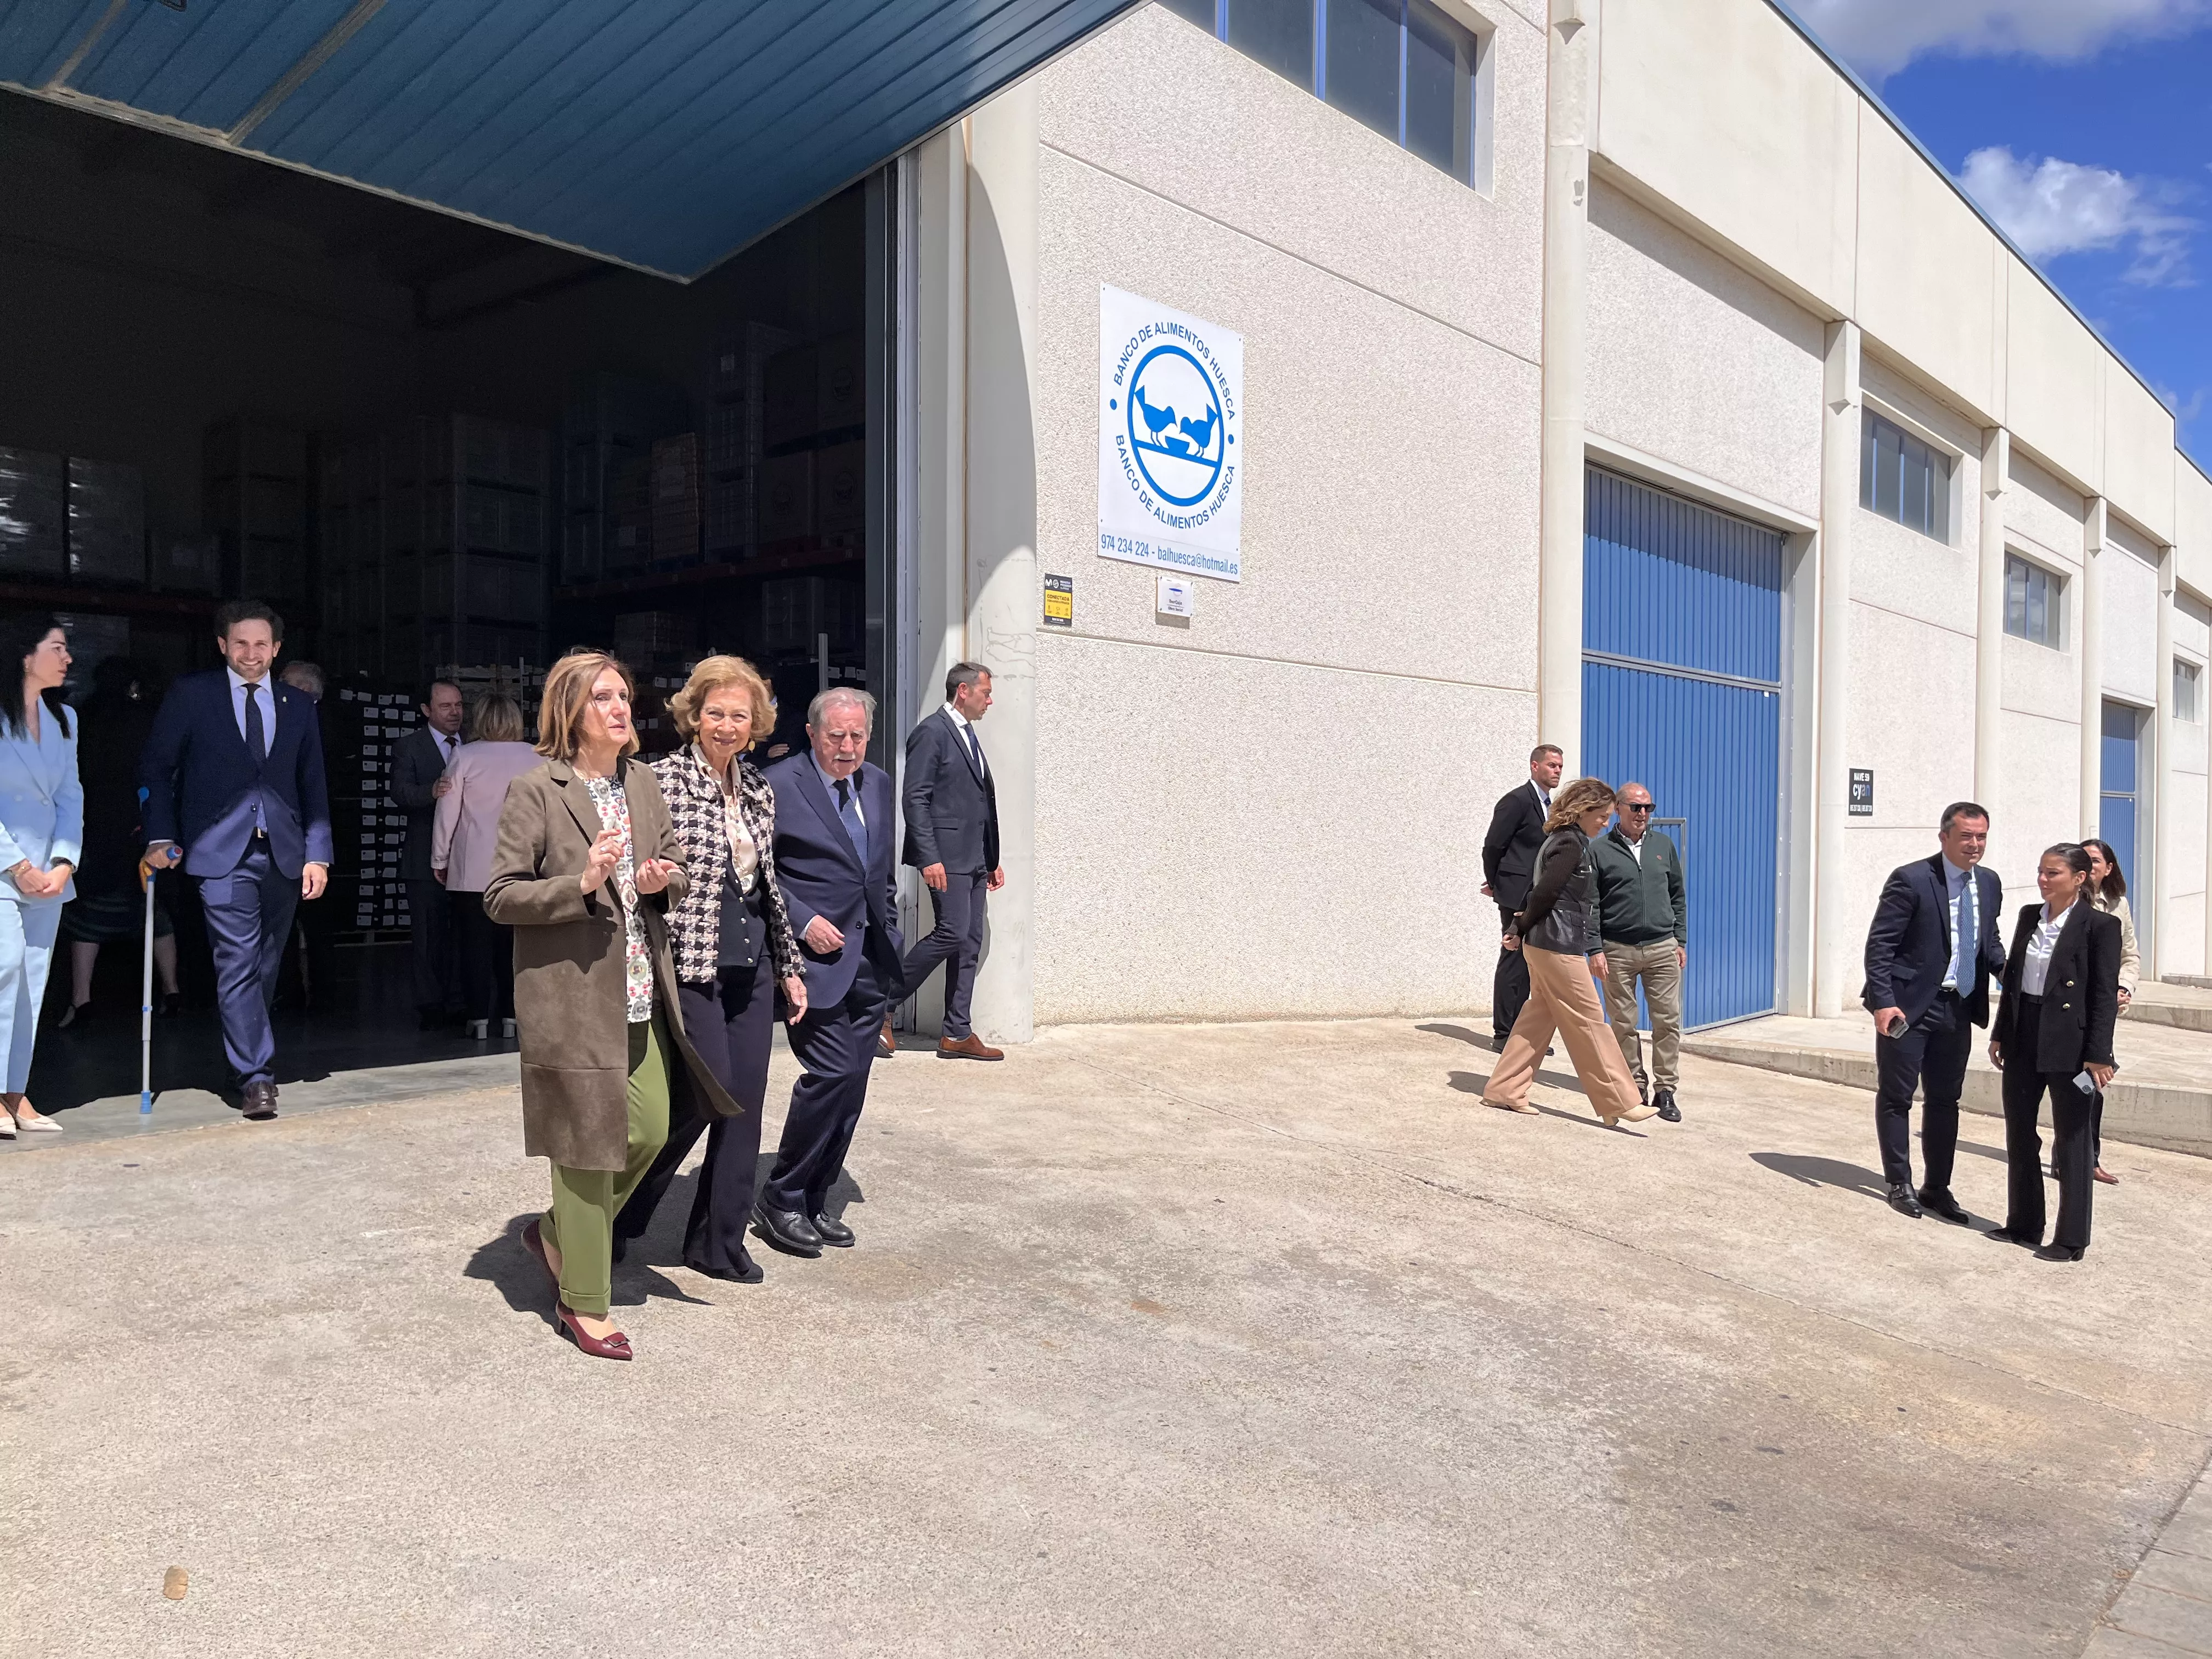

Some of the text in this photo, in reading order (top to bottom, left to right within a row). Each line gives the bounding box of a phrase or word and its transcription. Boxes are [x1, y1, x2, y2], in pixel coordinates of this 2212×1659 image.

[1114, 321, 1235, 420] BANCO DE ALIMENTOS HUESCA
[1115, 434, 1235, 529] BANCO DE ALIMENTOS HUESCA
[1101, 534, 1115, 550] 974
[1118, 537, 1133, 554] 234
[1135, 540, 1149, 557] 224
[1158, 545, 1238, 575] balhuesca@hotmail.es
[1853, 783, 1870, 800] cyan
[1854, 772, 1864, 781] NAVE
